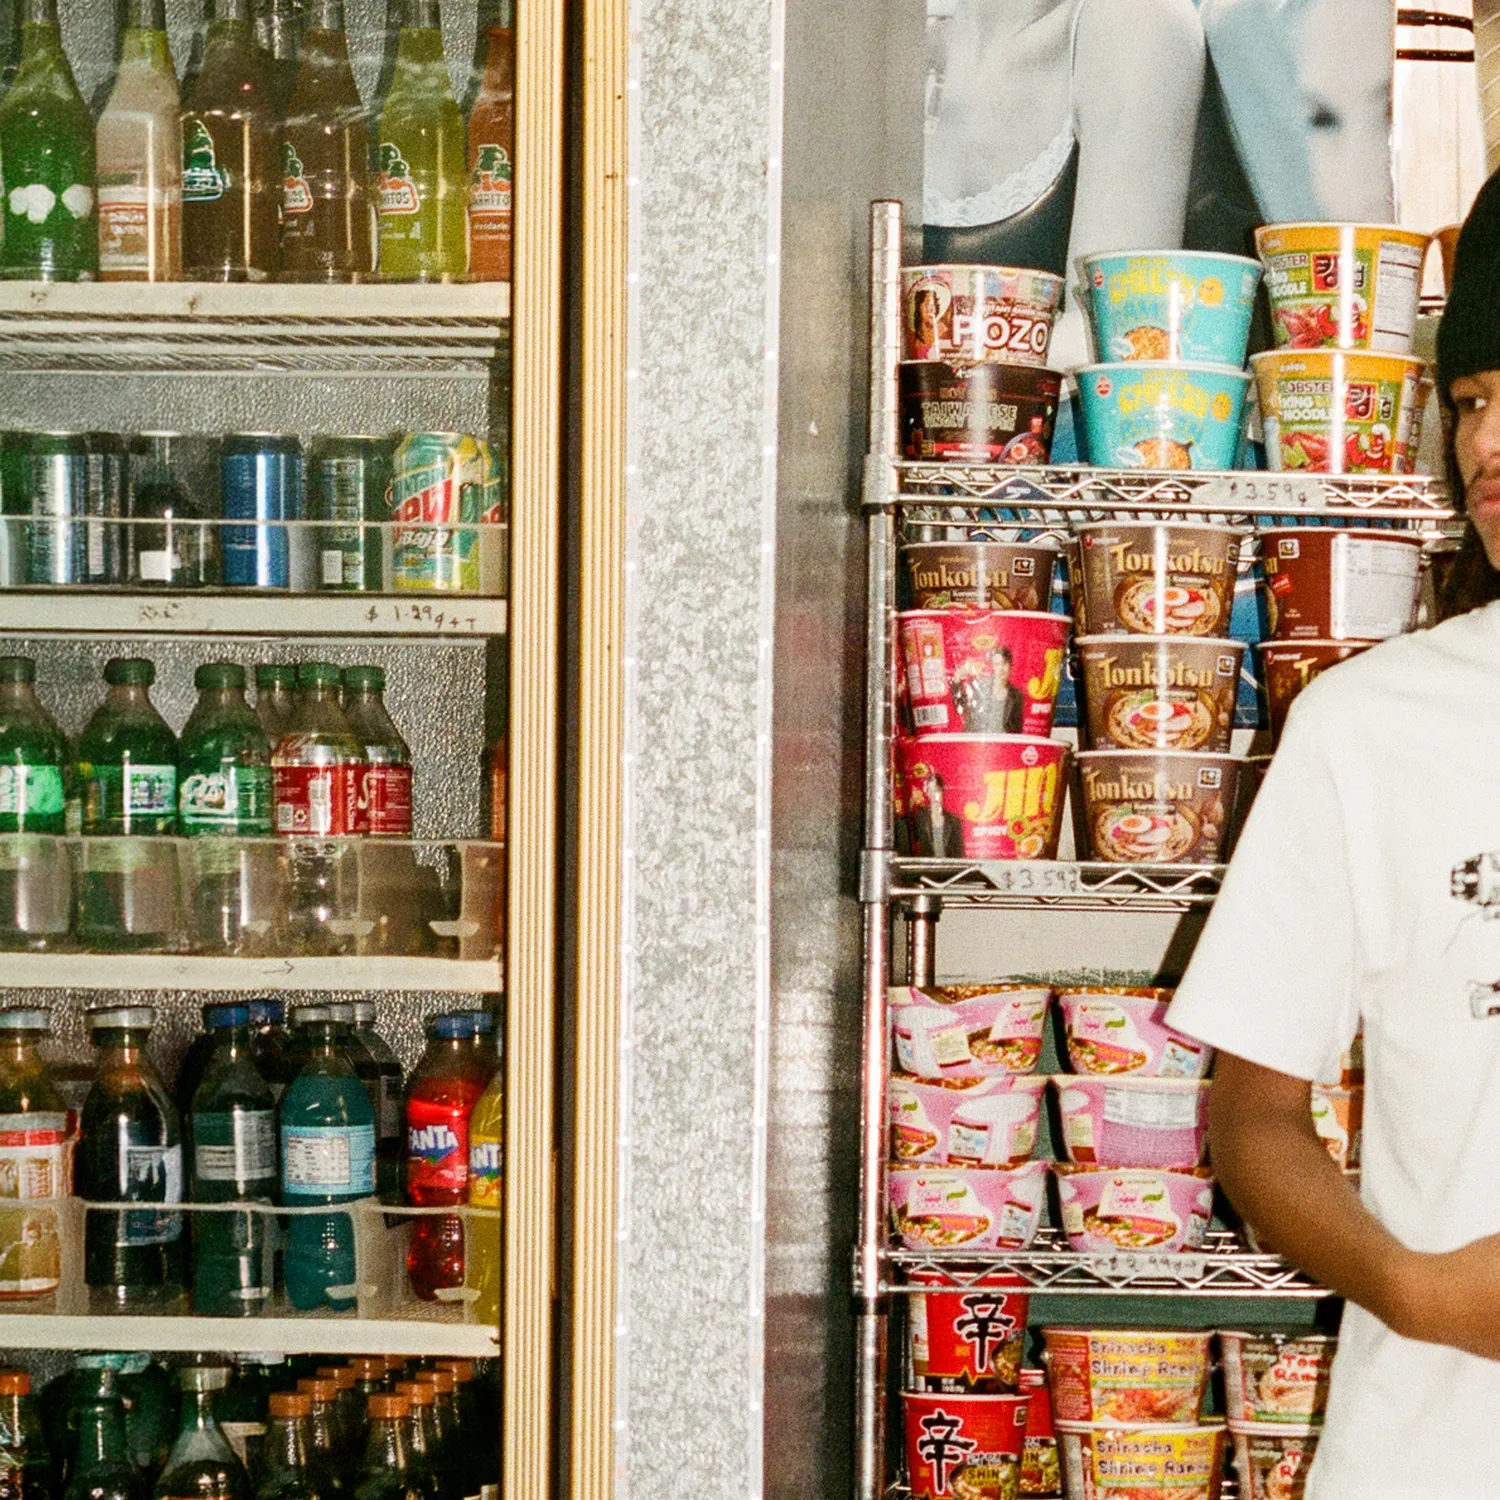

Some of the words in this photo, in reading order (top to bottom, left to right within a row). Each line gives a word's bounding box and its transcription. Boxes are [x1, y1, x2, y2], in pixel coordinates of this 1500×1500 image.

[1280, 380, 1337, 394] LOBSTE
[920, 402, 1018, 419] TAIWAESE
[1281, 408, 1336, 422] NOODL
[954, 1292, 1016, 1374] 辛
[917, 1407, 978, 1495] 辛
[1025, 1450, 1039, 1463] IN
[967, 1467, 1001, 1480] SHIN
